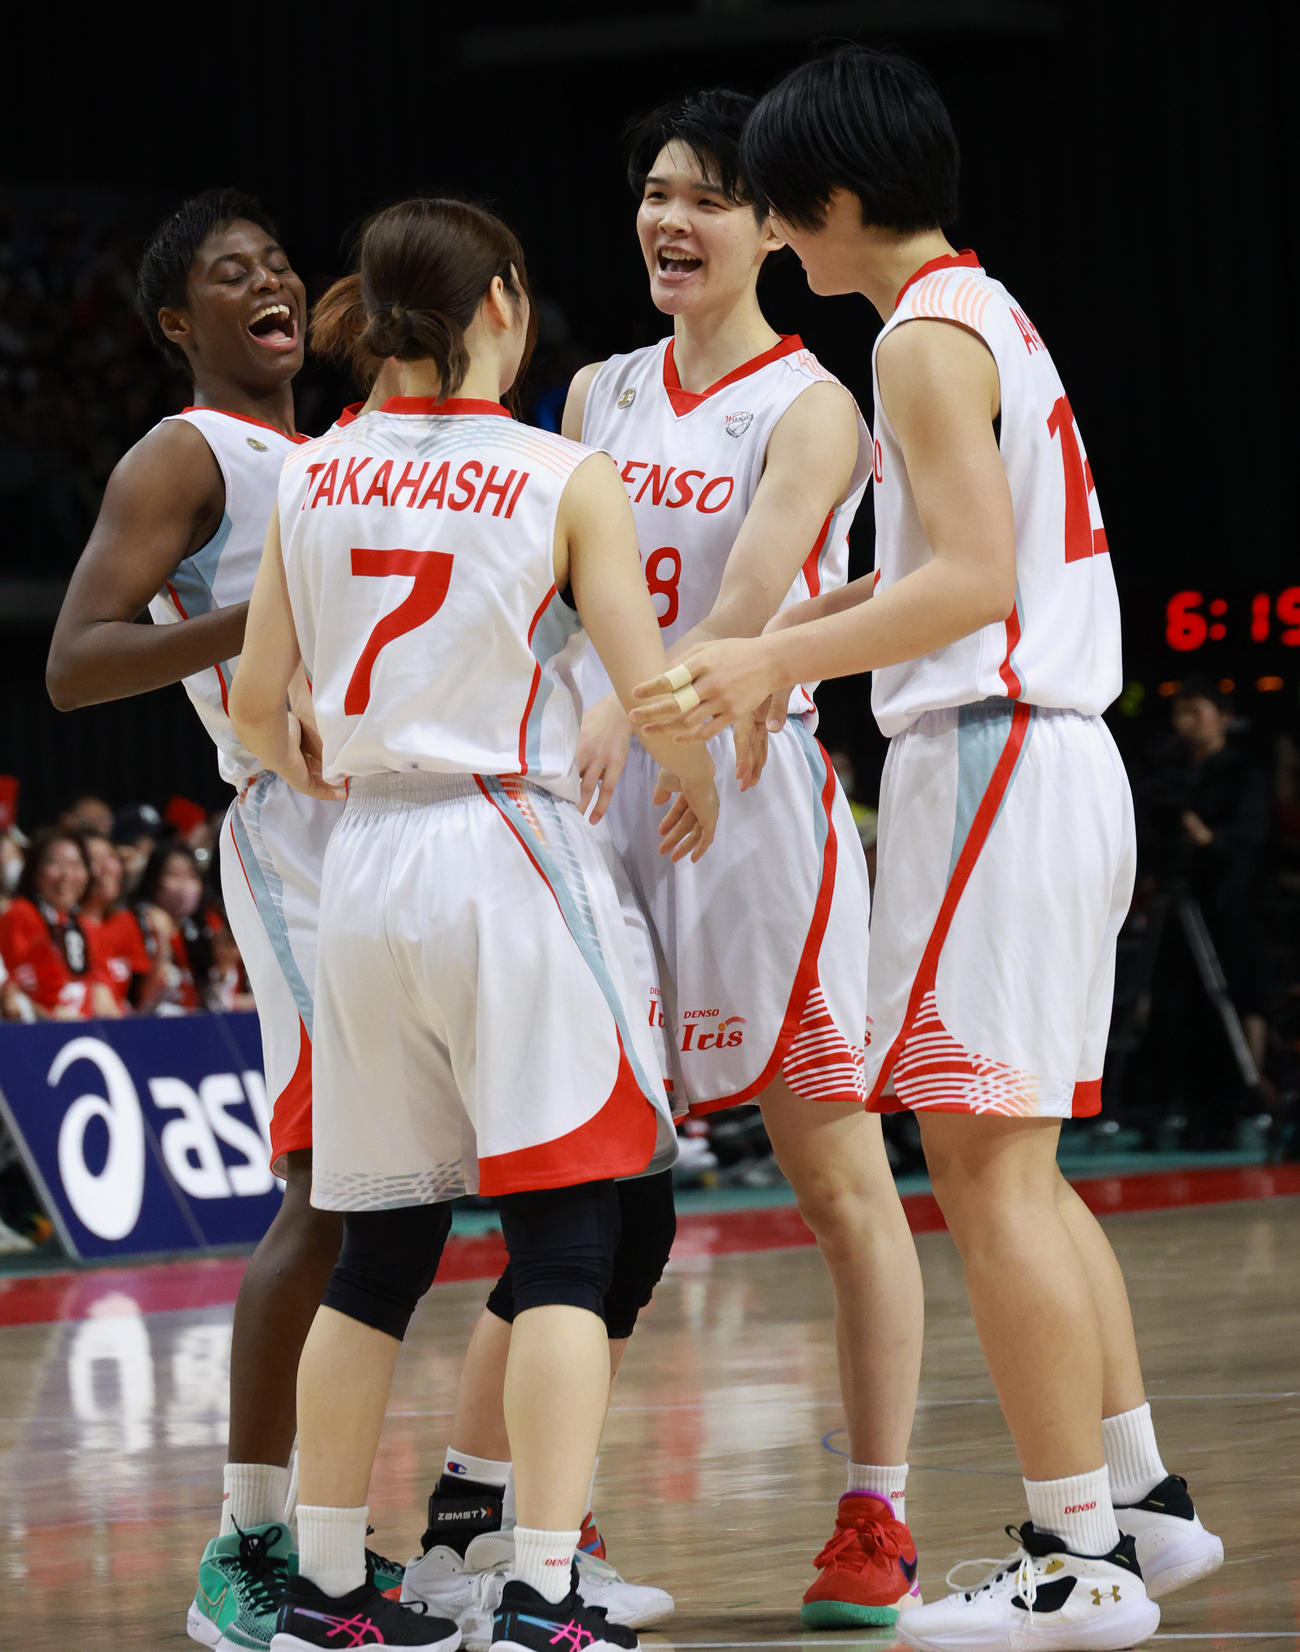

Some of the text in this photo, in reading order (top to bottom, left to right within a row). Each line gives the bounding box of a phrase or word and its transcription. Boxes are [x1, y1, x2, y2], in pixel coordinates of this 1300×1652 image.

[301, 456, 531, 519] TAKAHASHI
[612, 460, 735, 514] ENSO
[344, 548, 455, 716] 7
[683, 1008, 720, 1019] DENSO
[680, 1022, 744, 1052] Iris
[1064, 1500, 1097, 1515] DENSO
